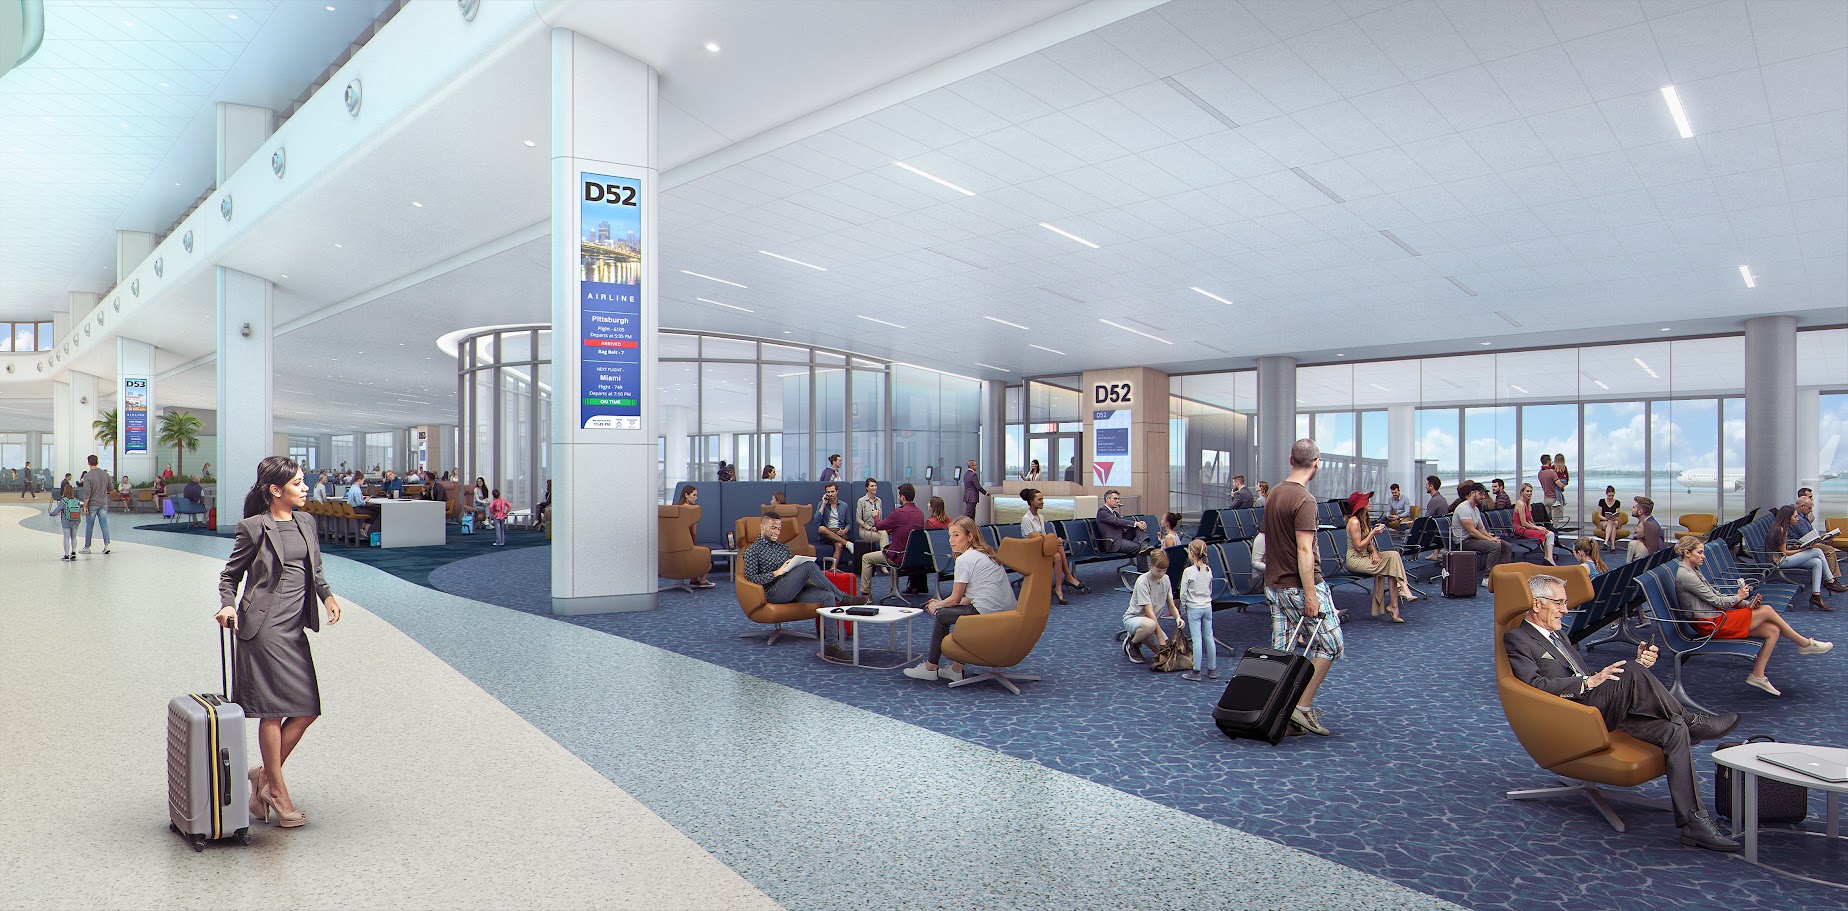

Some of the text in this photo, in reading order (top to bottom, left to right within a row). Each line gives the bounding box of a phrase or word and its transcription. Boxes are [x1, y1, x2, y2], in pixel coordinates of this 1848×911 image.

[585, 181, 637, 207] D52
[587, 292, 635, 302] AIRLINE
[592, 316, 629, 325] Pittsburgh
[1096, 384, 1132, 404] D52
